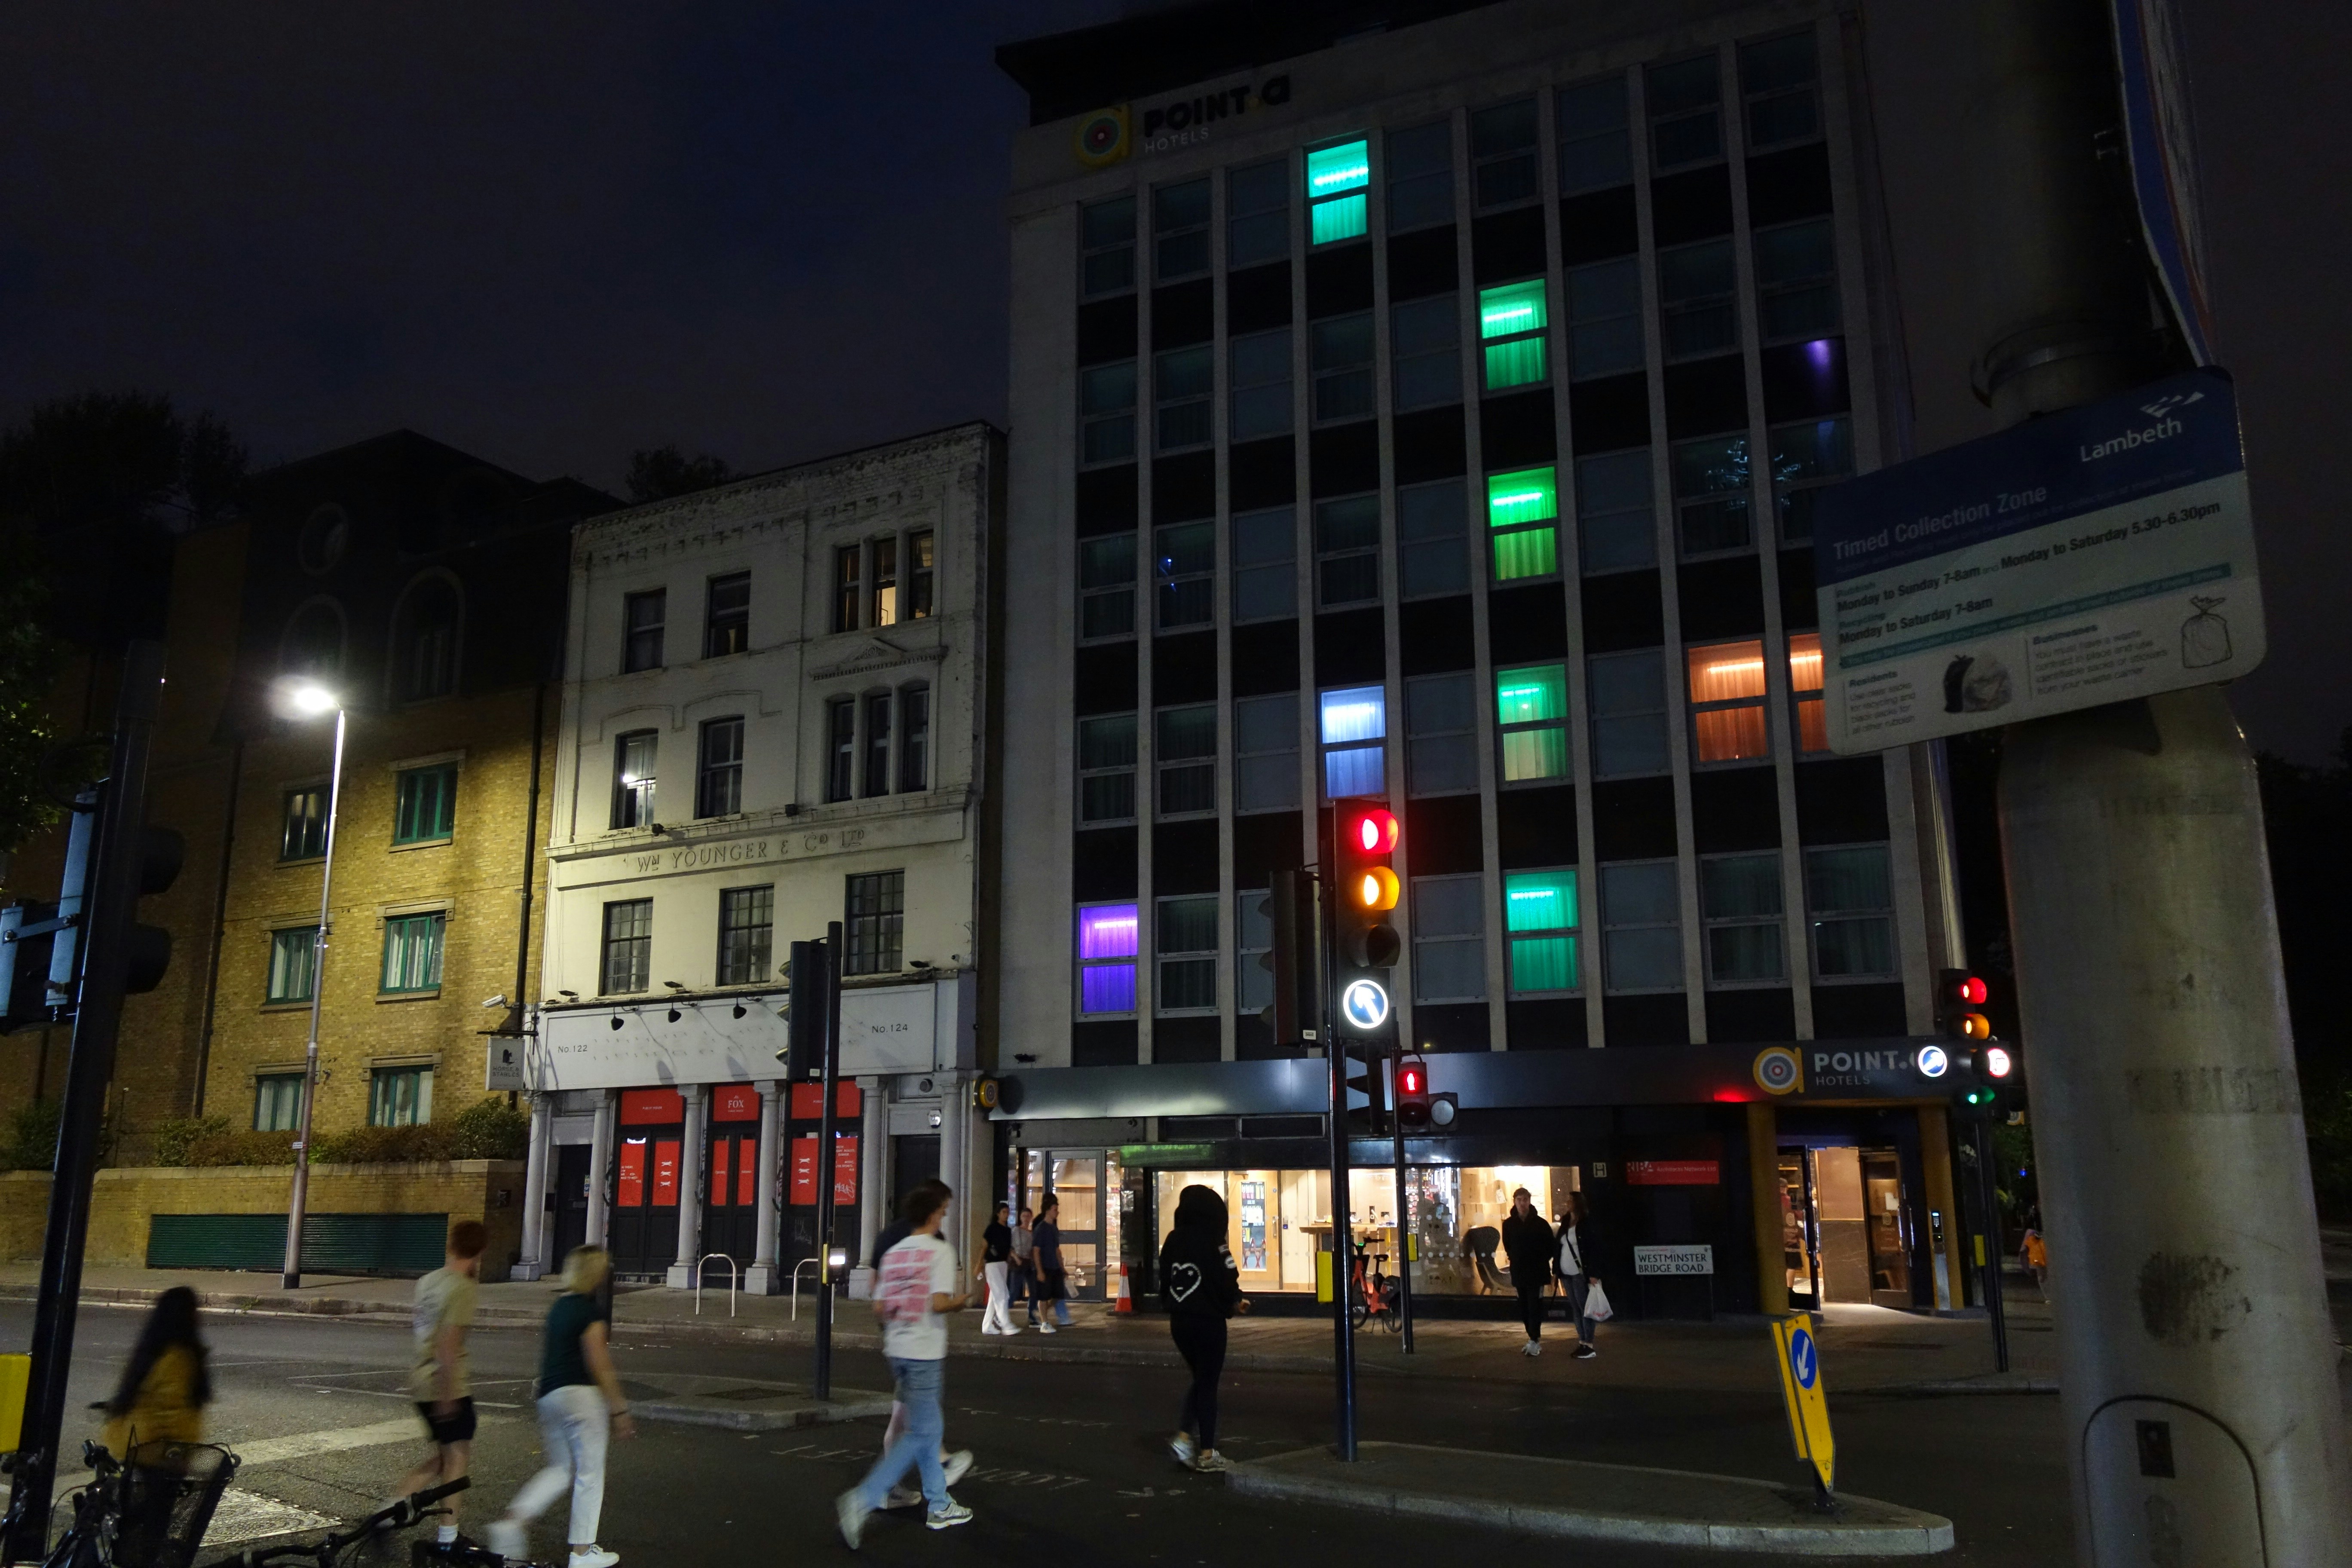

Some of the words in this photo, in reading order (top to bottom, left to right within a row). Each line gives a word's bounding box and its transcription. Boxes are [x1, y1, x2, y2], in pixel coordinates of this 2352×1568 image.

[1145, 127, 1209, 152] HOTELS
[2081, 418, 2181, 461] Lambeth
[1834, 529, 1888, 559] Timed
[1895, 503, 1989, 541] Collection
[1997, 487, 2046, 513] Zone
[1836, 594, 1880, 612] Monday
[1883, 589, 1895, 600] to
[1898, 578, 1939, 596] Sunday
[1944, 567, 1981, 584] 7-8am
[2001, 548, 2049, 568] Monday
[2053, 544, 2066, 555] to
[2070, 527, 2128, 550] Saturday
[1838, 626, 1881, 644] Monday
[1885, 622, 1897, 632] to
[1900, 608, 1951, 629] Saturday
[1955, 597, 1993, 614] 7-8am
[672, 841, 767, 868] YOUNGER
[1816, 1076, 1871, 1086] HOTELS
[728, 1099, 744, 1109] FOX
[1638, 1253, 1707, 1263] WESTMINSTER
[1639, 1265, 1672, 1273] BRIDGE
[1675, 1264, 1704, 1272] ROAD
